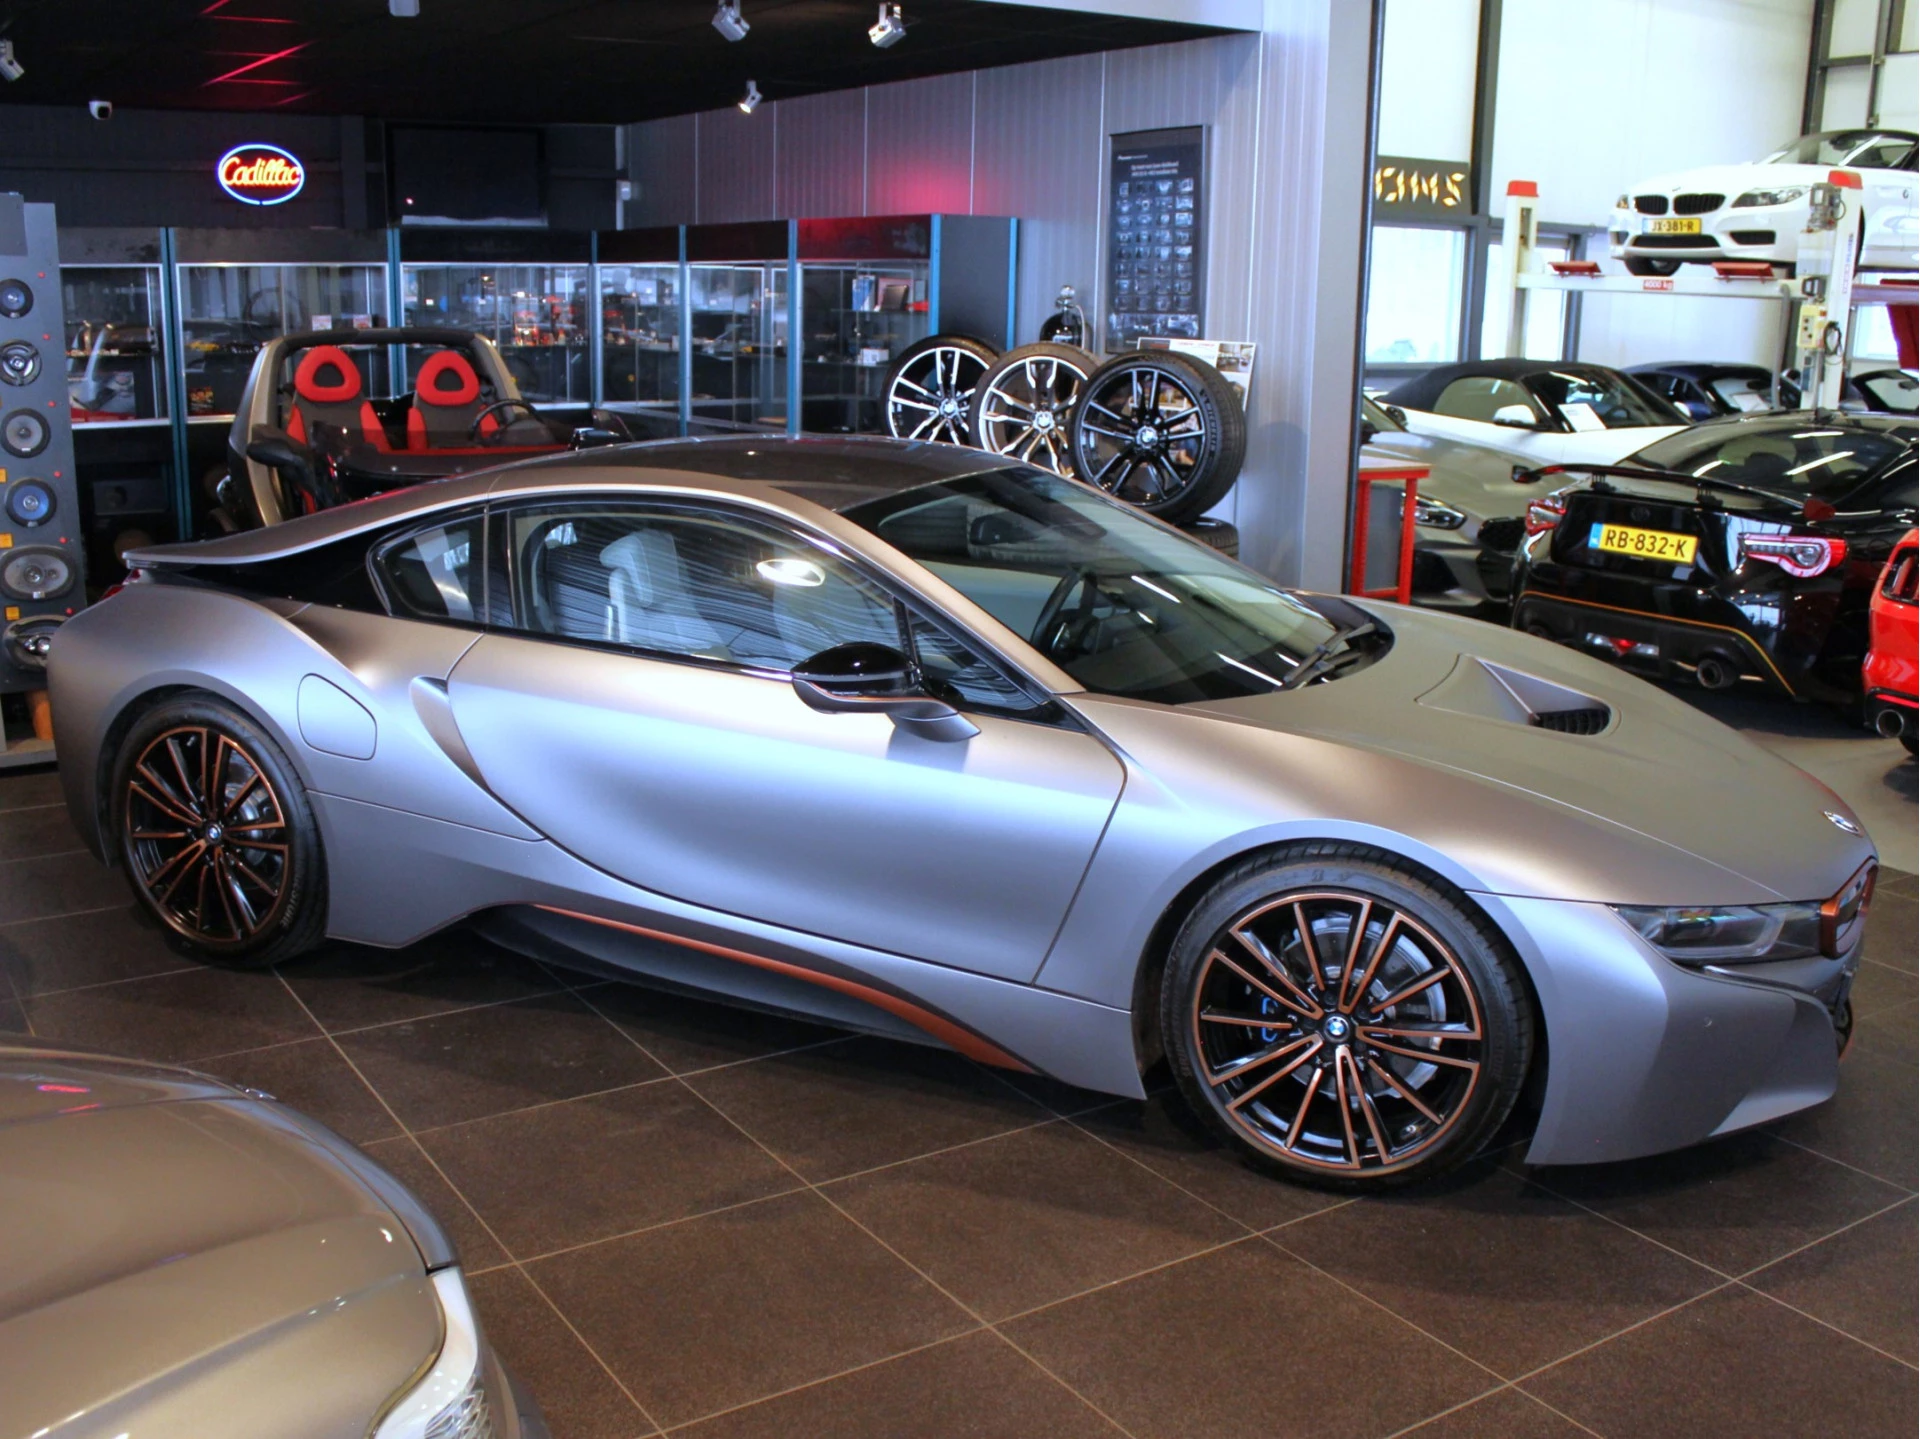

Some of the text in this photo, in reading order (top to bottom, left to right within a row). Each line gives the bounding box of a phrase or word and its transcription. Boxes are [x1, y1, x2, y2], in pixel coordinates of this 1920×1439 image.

[222, 156, 301, 186] Cadillac
[1652, 219, 1694, 232] JX-381-R
[1605, 529, 1688, 558] RB-832-K
